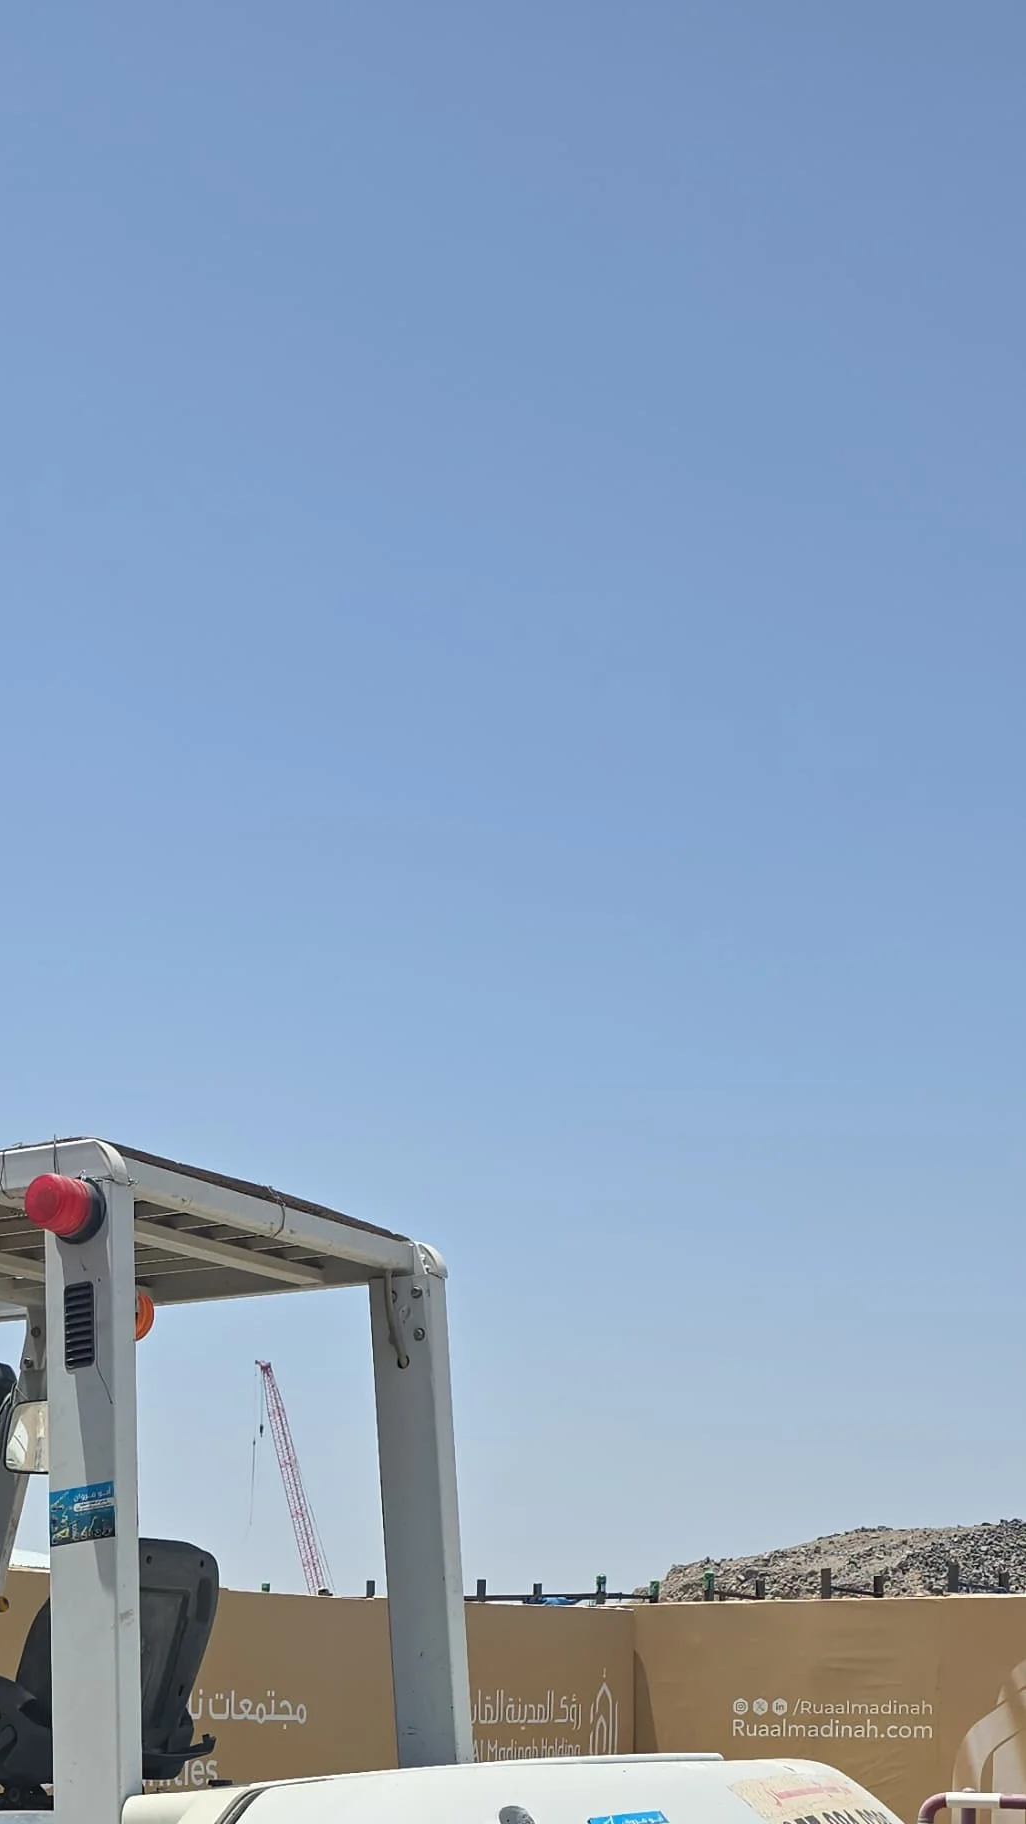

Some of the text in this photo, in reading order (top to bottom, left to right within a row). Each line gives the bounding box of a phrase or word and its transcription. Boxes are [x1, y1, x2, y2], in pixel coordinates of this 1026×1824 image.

[208, 1689, 307, 1730] مجتمعات
[506, 1689, 554, 1731] المدينة
[792, 1698, 933, 1716] /Ruaalmadinah
[732, 1718, 933, 1739] Ruaalmadinah.com
